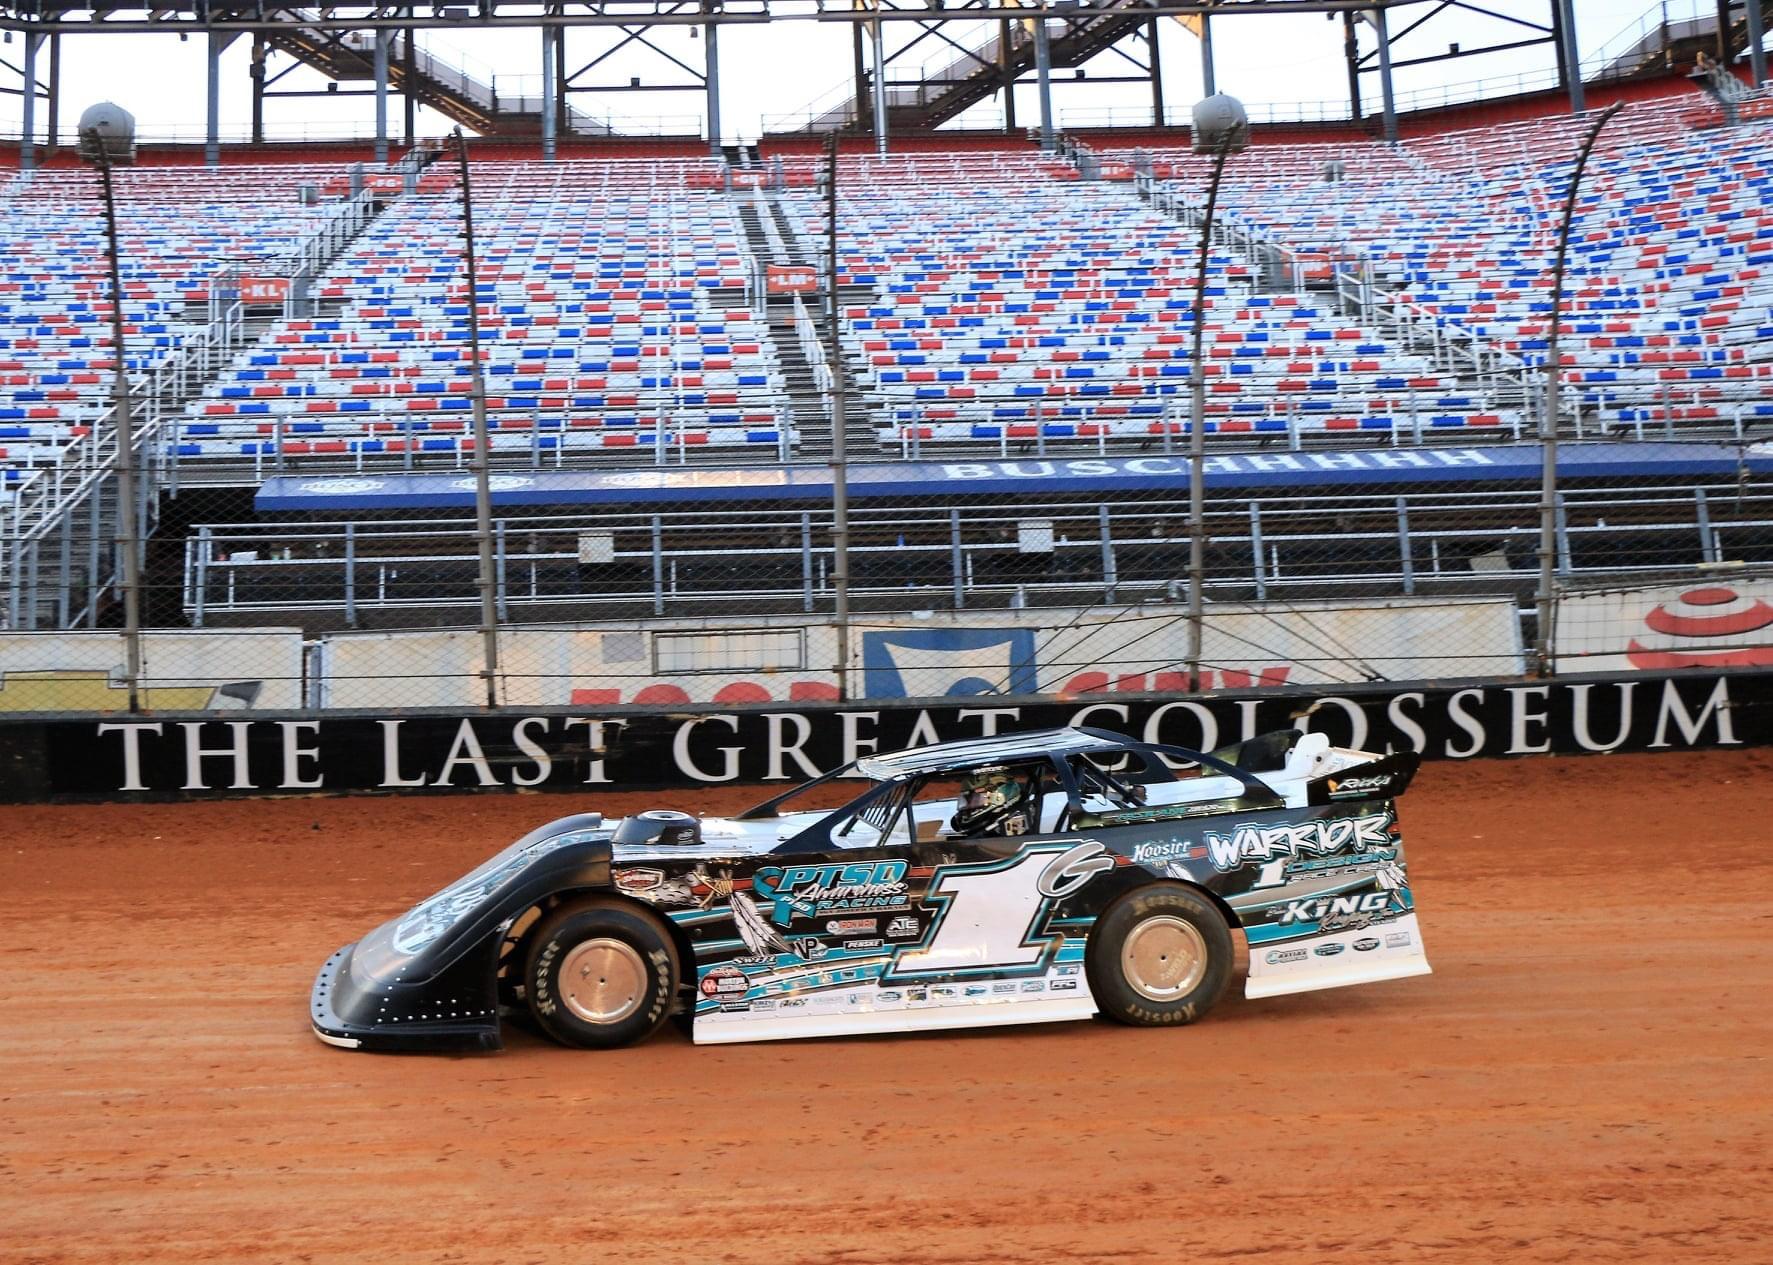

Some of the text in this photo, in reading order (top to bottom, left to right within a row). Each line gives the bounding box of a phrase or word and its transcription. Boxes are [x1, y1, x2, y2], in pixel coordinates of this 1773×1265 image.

[251, 284, 280, 297] KL
[98, 720, 324, 790] THE
[375, 716, 631, 787] LAST
[1131, 839, 1191, 862] Hoosier
[1205, 815, 1389, 869] WARRIOR
[776, 860, 909, 892] PTSD
[817, 895, 908, 910] RACING
